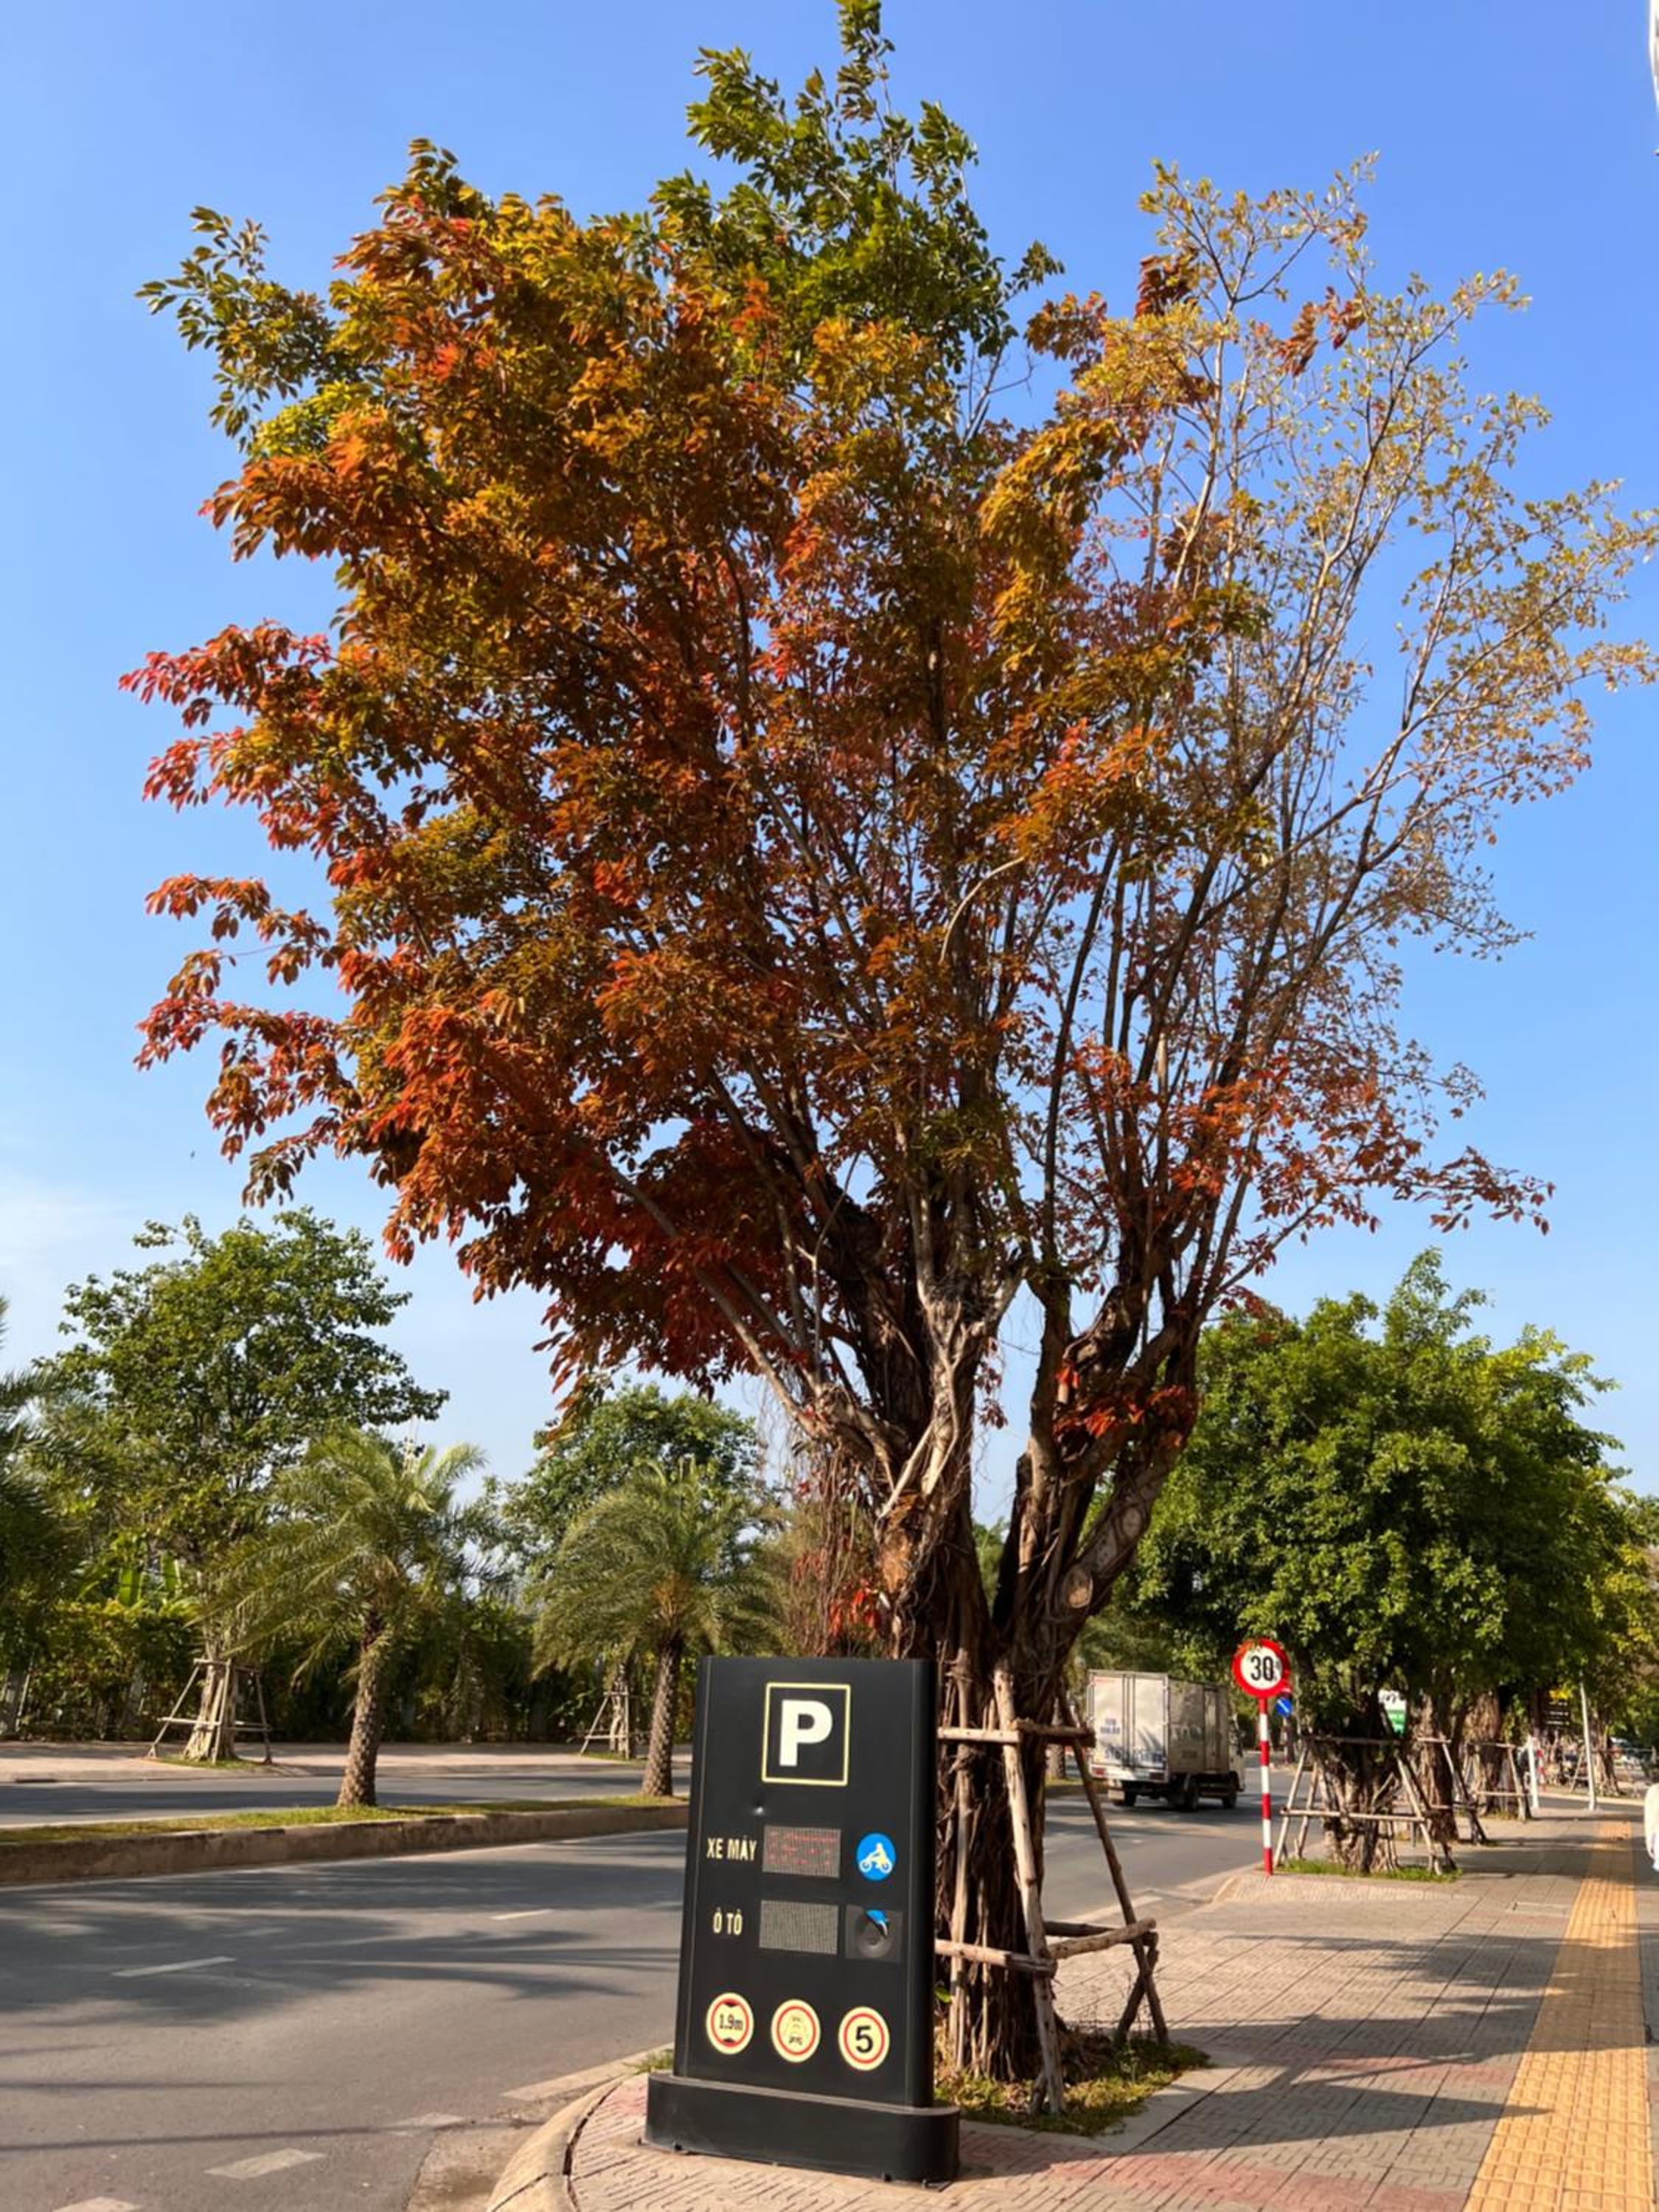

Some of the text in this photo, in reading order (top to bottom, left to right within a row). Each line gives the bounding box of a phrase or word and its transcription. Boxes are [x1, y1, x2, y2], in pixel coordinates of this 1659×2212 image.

[1250, 1655, 1274, 1681] 30
[779, 1700, 833, 1767] P
[706, 1837, 723, 1859] XE
[726, 1834, 757, 1861] MÁY
[855, 2025, 874, 2053] 5
